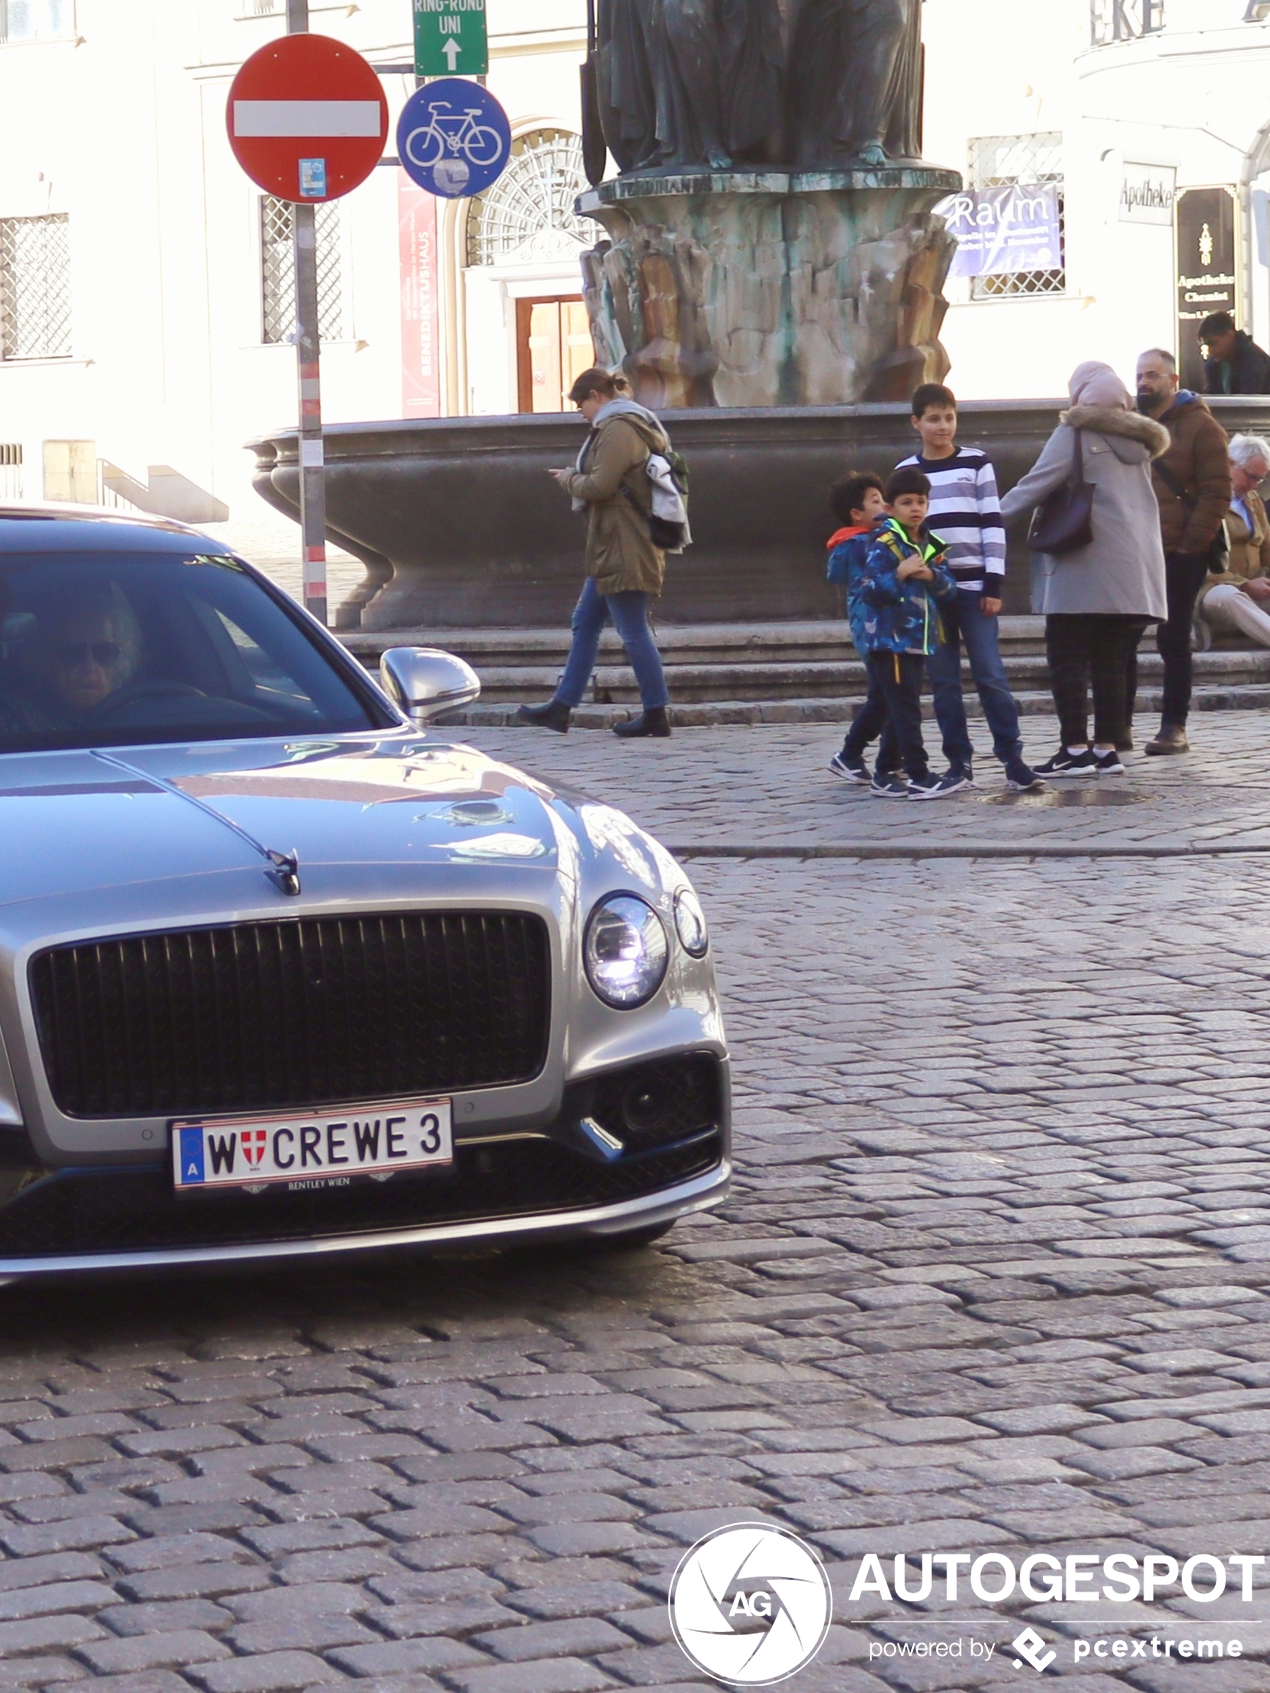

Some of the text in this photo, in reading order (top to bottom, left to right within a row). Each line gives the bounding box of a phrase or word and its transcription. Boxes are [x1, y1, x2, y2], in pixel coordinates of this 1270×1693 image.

[414, 0, 484, 12] RING-RUND
[439, 15, 461, 34] UNI
[1120, 178, 1172, 212] Apotheke
[953, 197, 1049, 228] Raum
[1178, 273, 1234, 289] Apotheke
[418, 231, 432, 376] BENEDIKTUSHAUS
[1184, 291, 1229, 302] Chemist
[187, 1112, 441, 1176] A W CREWE 3
[288, 1177, 350, 1190] BENTLEY WIEN
